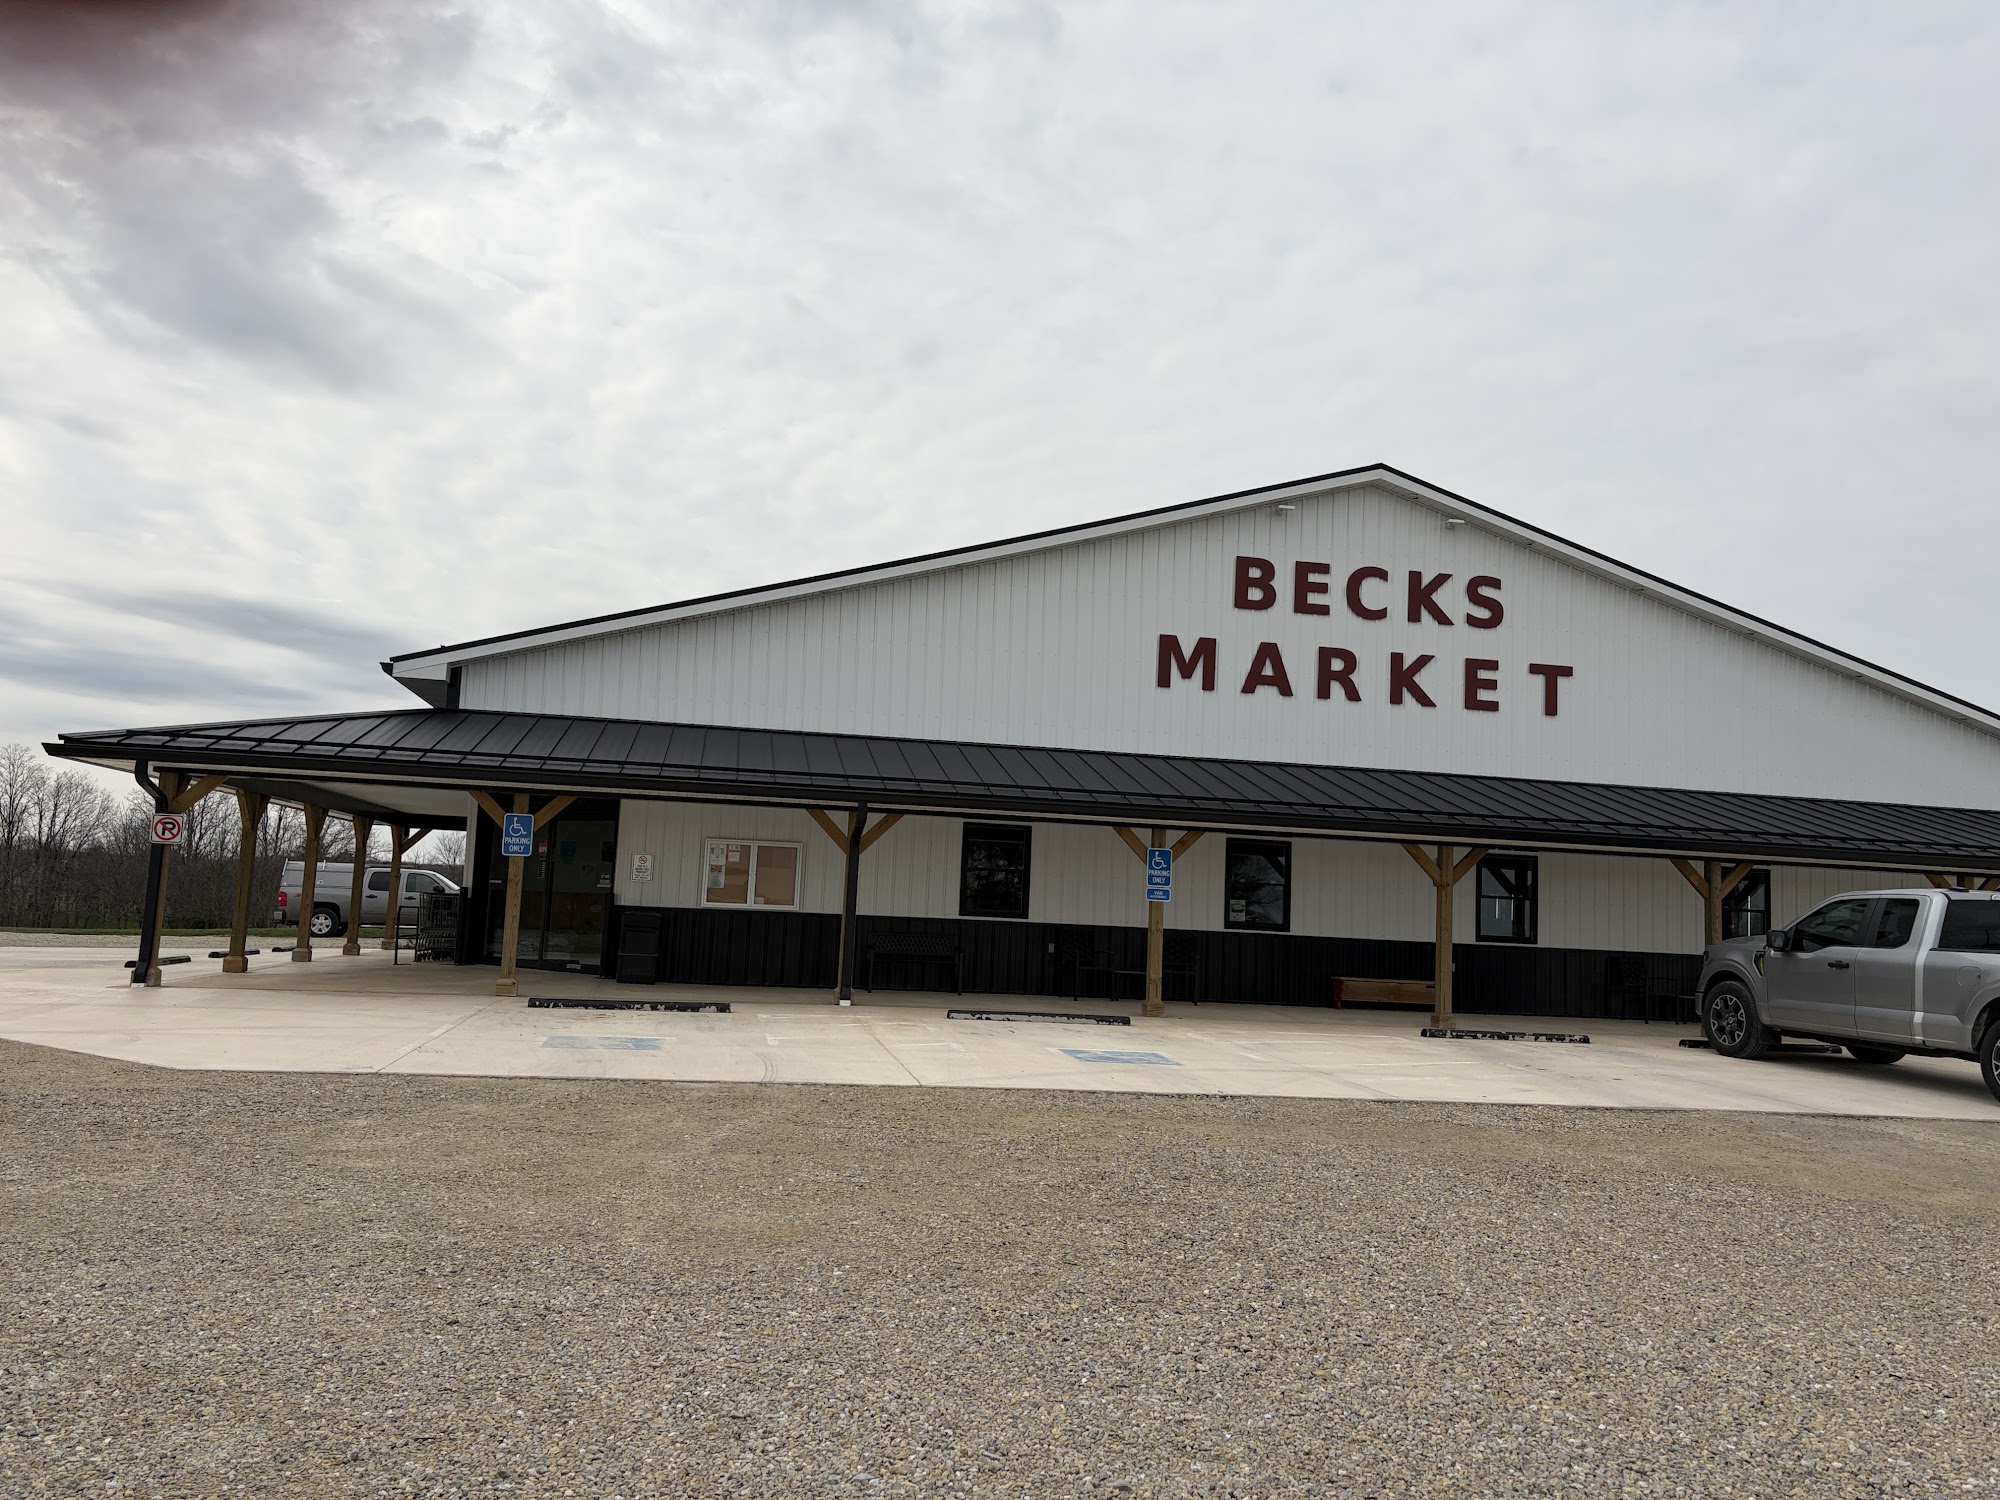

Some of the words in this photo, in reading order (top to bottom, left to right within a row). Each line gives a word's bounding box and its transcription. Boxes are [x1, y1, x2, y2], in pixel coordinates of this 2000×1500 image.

[1234, 555, 1505, 629] BECKS
[1157, 633, 1574, 717] MARKET
[504, 837, 531, 845] PARKING
